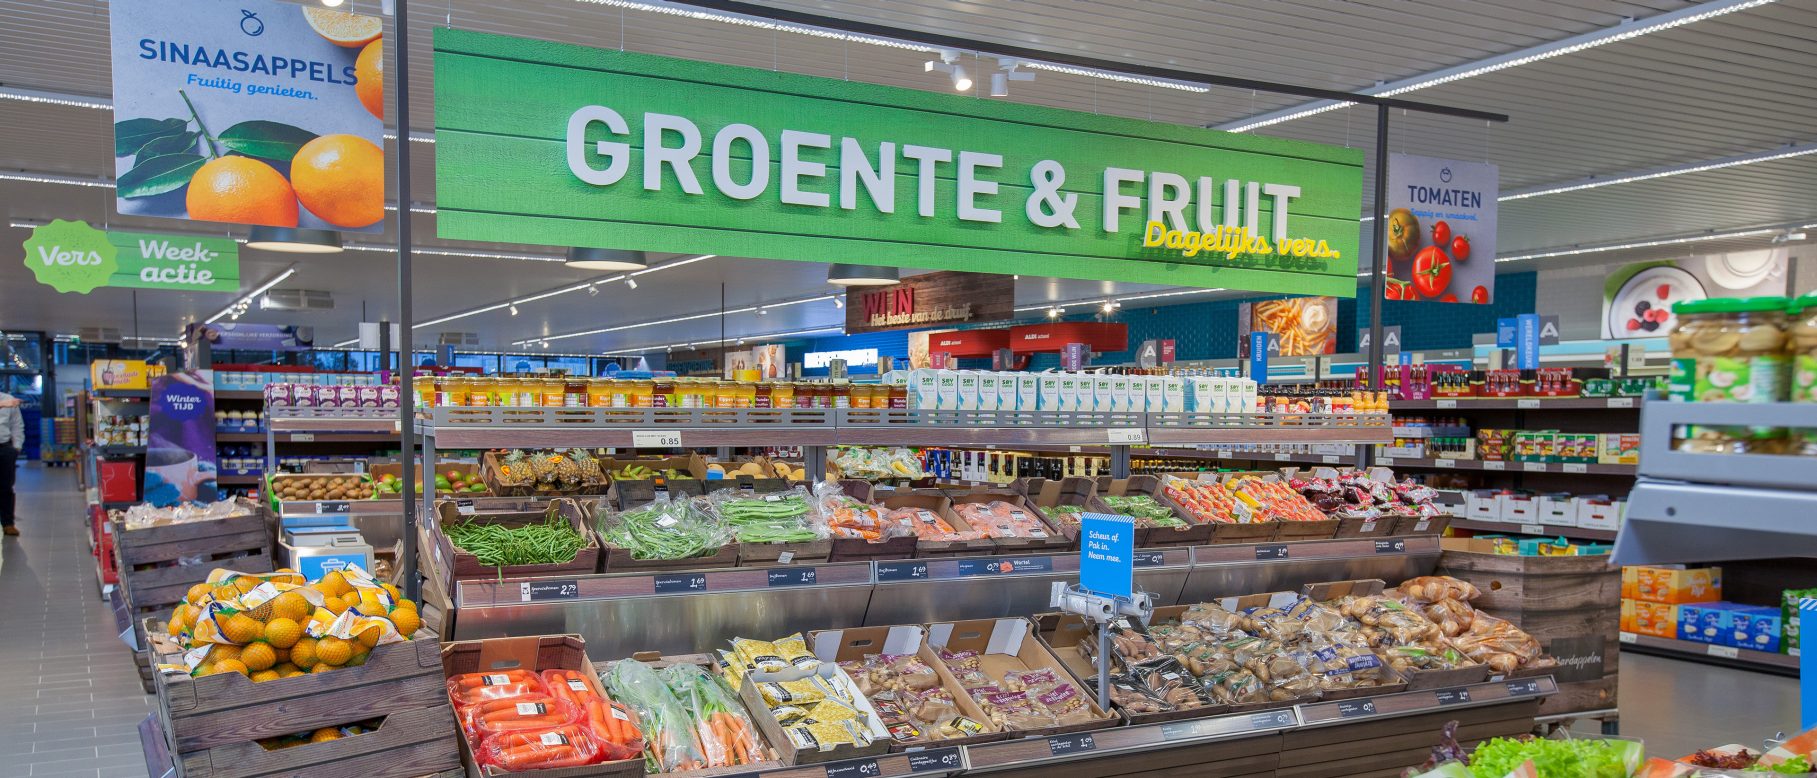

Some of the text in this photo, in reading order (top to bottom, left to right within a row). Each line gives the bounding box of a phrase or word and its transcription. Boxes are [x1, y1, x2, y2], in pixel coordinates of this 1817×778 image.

[138, 38, 359, 88] SINAASAPPELS
[187, 72, 319, 101] Fruitig genieten.
[566, 104, 1301, 245] GROENTE & FRUIT
[1407, 185, 1482, 209] TOMATEN
[1144, 221, 1341, 260] Dagelijks vers.
[37, 244, 103, 269] Vers
[139, 239, 219, 263] Week-
[140, 262, 215, 286] actie
[861, 287, 915, 323] WIJN
[871, 302, 974, 327] Het beste van de druif.
[1539, 322, 1559, 338] A
[1267, 338, 1280, 351] A
[1384, 332, 1400, 347] A
[1525, 319, 1534, 369] WERELDKEUKE
[1144, 345, 1156, 357] A
[166, 393, 202, 404] Winter
[173, 402, 194, 411] TIJD
[660, 437, 679, 445] 0.85
[1088, 530, 1120, 542] Scheur af.
[1088, 540, 1110, 551] Pak in.
[1088, 551, 1105, 560] Neem
[1105, 554, 1122, 563] mee.
[801, 571, 815, 582] 1.69
[911, 566, 927, 577] 1.69
[560, 584, 577, 595] 2.79
[689, 577, 705, 589] 1.69
